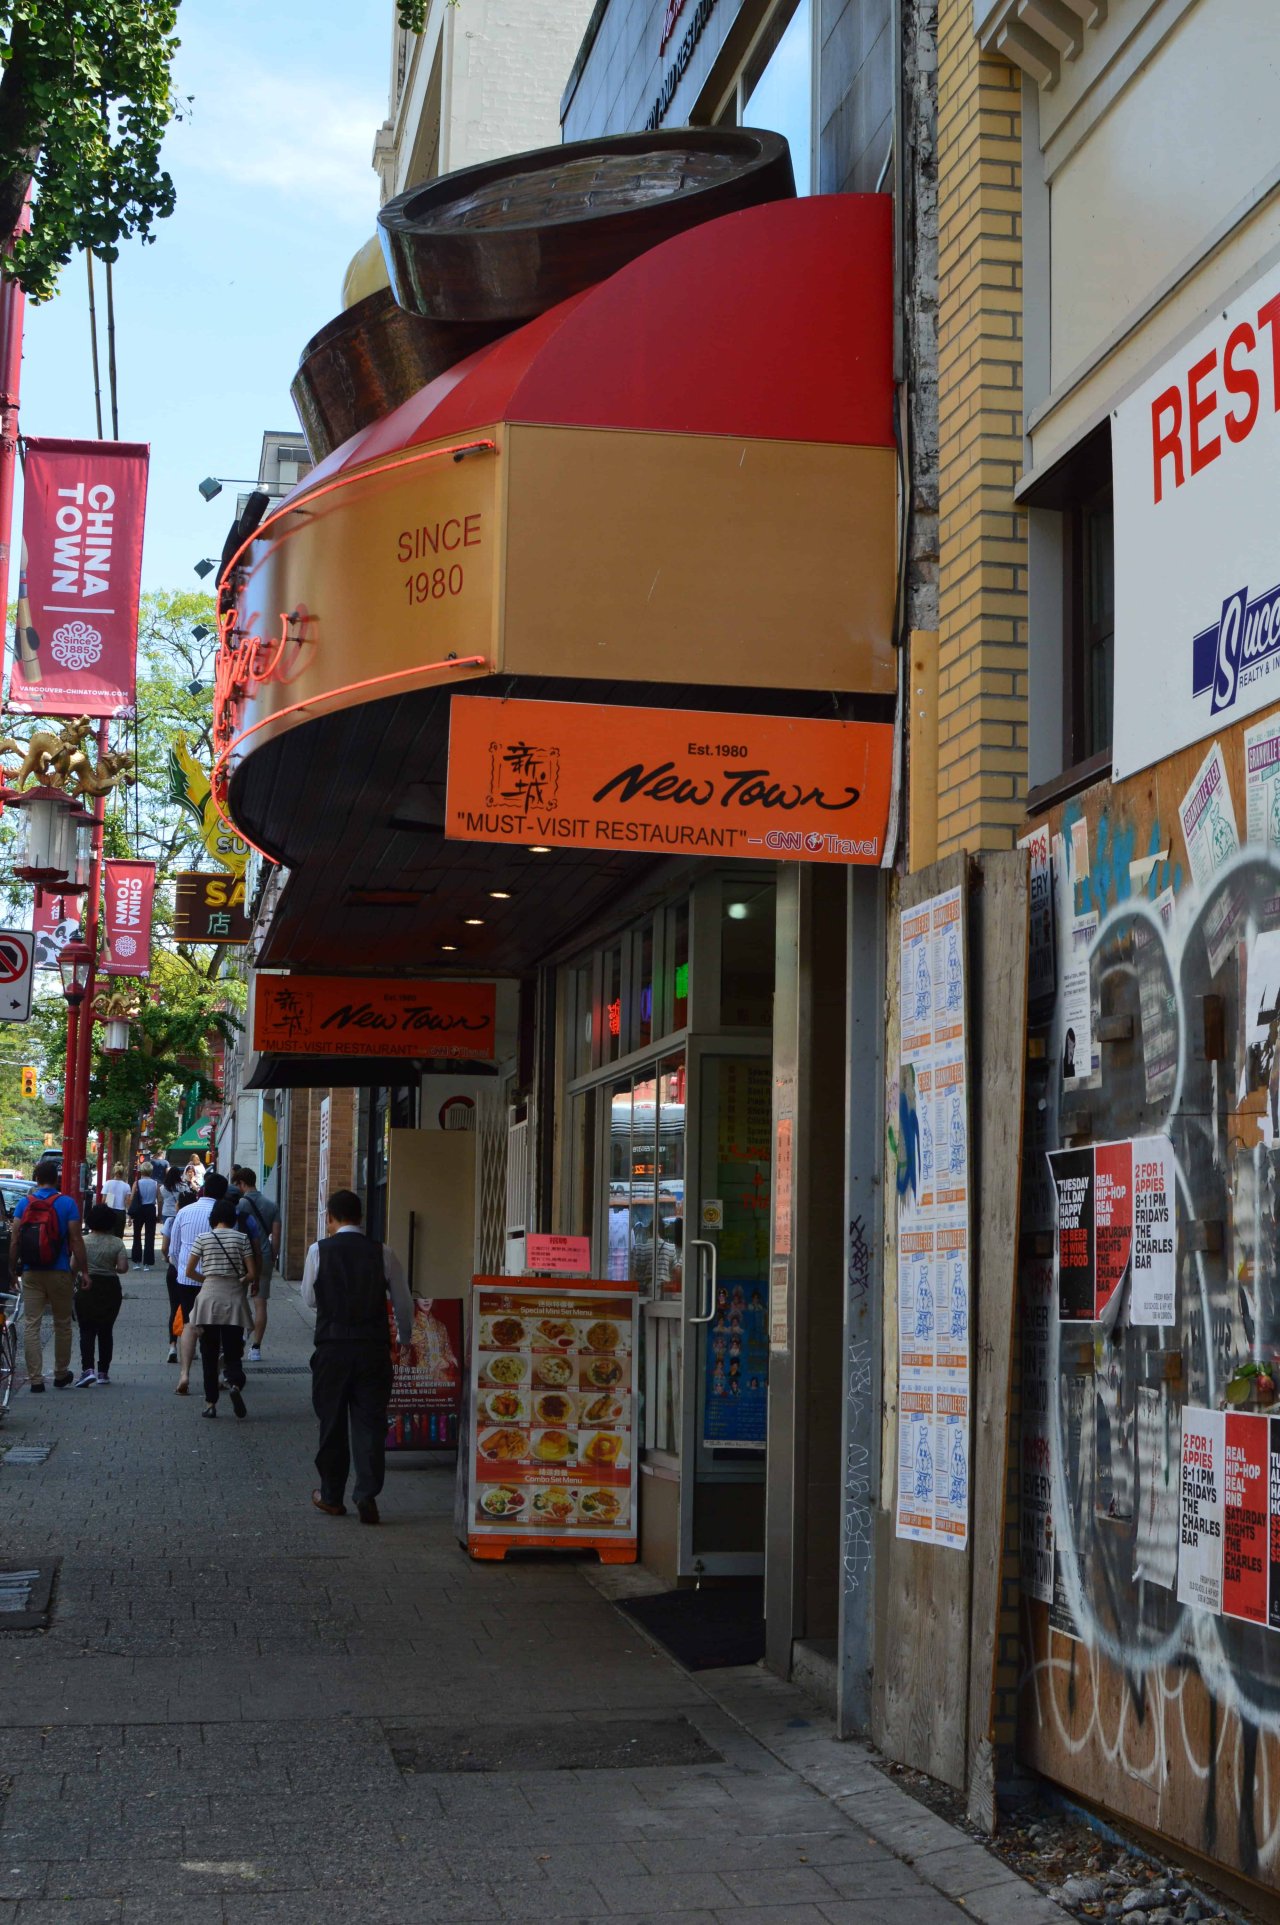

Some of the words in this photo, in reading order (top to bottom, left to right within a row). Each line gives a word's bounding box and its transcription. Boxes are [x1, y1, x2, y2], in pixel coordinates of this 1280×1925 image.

[51, 483, 84, 594] TOWN
[82, 484, 115, 598] CHINA
[398, 513, 481, 563] SINCE
[405, 564, 463, 605] 1980
[63, 632, 91, 646] Since
[64, 644, 90, 655] 1885
[1239, 663, 1264, 689] REALTY
[1265, 661, 1270, 674] &
[19, 685, 129, 698] VANCOUVER-CHINATOWN.COM
[687, 742, 748, 758] Est.1980
[501, 741, 549, 814] 新城
[592, 761, 714, 807] New
[720, 769, 860, 810] Town
[1185, 783, 1208, 836] GRANVILLE
[457, 811, 590, 839] "MUST-VISIT
[595, 819, 747, 847] RESTAURANT"
[766, 831, 802, 850] CNN
[825, 834, 878, 856] Travel
[1031, 871, 1049, 899] ERY
[115, 878, 129, 925] TOWN
[128, 879, 142, 926] CHINA
[207, 911, 231, 935] 店
[320, 1003, 397, 1030] New
[402, 1006, 490, 1030] Town
[1135, 1164, 1141, 1178] 2
[1141, 1162, 1158, 1177] FOR
[1159, 1162, 1164, 1175] 1
[1058, 1177, 1089, 1191] TUESDAY
[1096, 1174, 1114, 1187] REAL
[1135, 1177, 1164, 1193] APPIES
[1060, 1191, 1072, 1204] ALL
[1072, 1190, 1085, 1203] DAY
[1096, 1186, 1126, 1200] HIP-HOP
[1135, 1193, 1166, 1209] 8-11PM
[1060, 1203, 1082, 1217] HAPPY
[1096, 1200, 1114, 1213] REAL
[1060, 1216, 1079, 1229] HOUR
[1096, 1214, 1111, 1227] RNB
[1135, 1208, 1169, 1223] FRIDAYS
[1069, 1228, 1088, 1241] BEER
[1096, 1225, 1132, 1238] SATURDAY
[1136, 1225, 1151, 1238] THE
[1069, 1241, 1087, 1253] WINE
[1096, 1239, 1121, 1251] NIGHTS
[1135, 1239, 1173, 1254] CHARLES
[1069, 1254, 1088, 1267] FOOD
[1096, 1253, 1110, 1265] THE
[1135, 1255, 1152, 1269] BAR
[1096, 1279, 1110, 1292] BAR
[520, 1306, 545, 1316] Special
[545, 1307, 560, 1315] Mini
[561, 1308, 571, 1316] Set
[572, 1309, 592, 1317] Menu
[1183, 1433, 1189, 1446] 2
[1190, 1434, 1207, 1450] FOR
[1209, 1438, 1213, 1451] 1
[1183, 1451, 1213, 1469] APPIES
[1226, 1446, 1246, 1463] REAL
[1183, 1466, 1214, 1486] 8-11PM
[1226, 1461, 1261, 1480] HIP-HOP
[525, 1475, 549, 1484] Combo
[550, 1476, 562, 1484] Set
[563, 1477, 583, 1485] Menu
[1225, 1476, 1246, 1493] REAL
[1182, 1482, 1217, 1503] FRIDAYS
[1225, 1491, 1242, 1507] RNB
[1182, 1498, 1199, 1515] THE
[1225, 1507, 1267, 1528] SATURDAY
[1182, 1514, 1220, 1538] CHARLES
[1225, 1522, 1255, 1540] NIGHTS
[1181, 1531, 1199, 1548] BAR
[1225, 1536, 1241, 1552] THE
[1225, 1551, 1262, 1573] CHARLES
[1225, 1566, 1241, 1583] BAR
